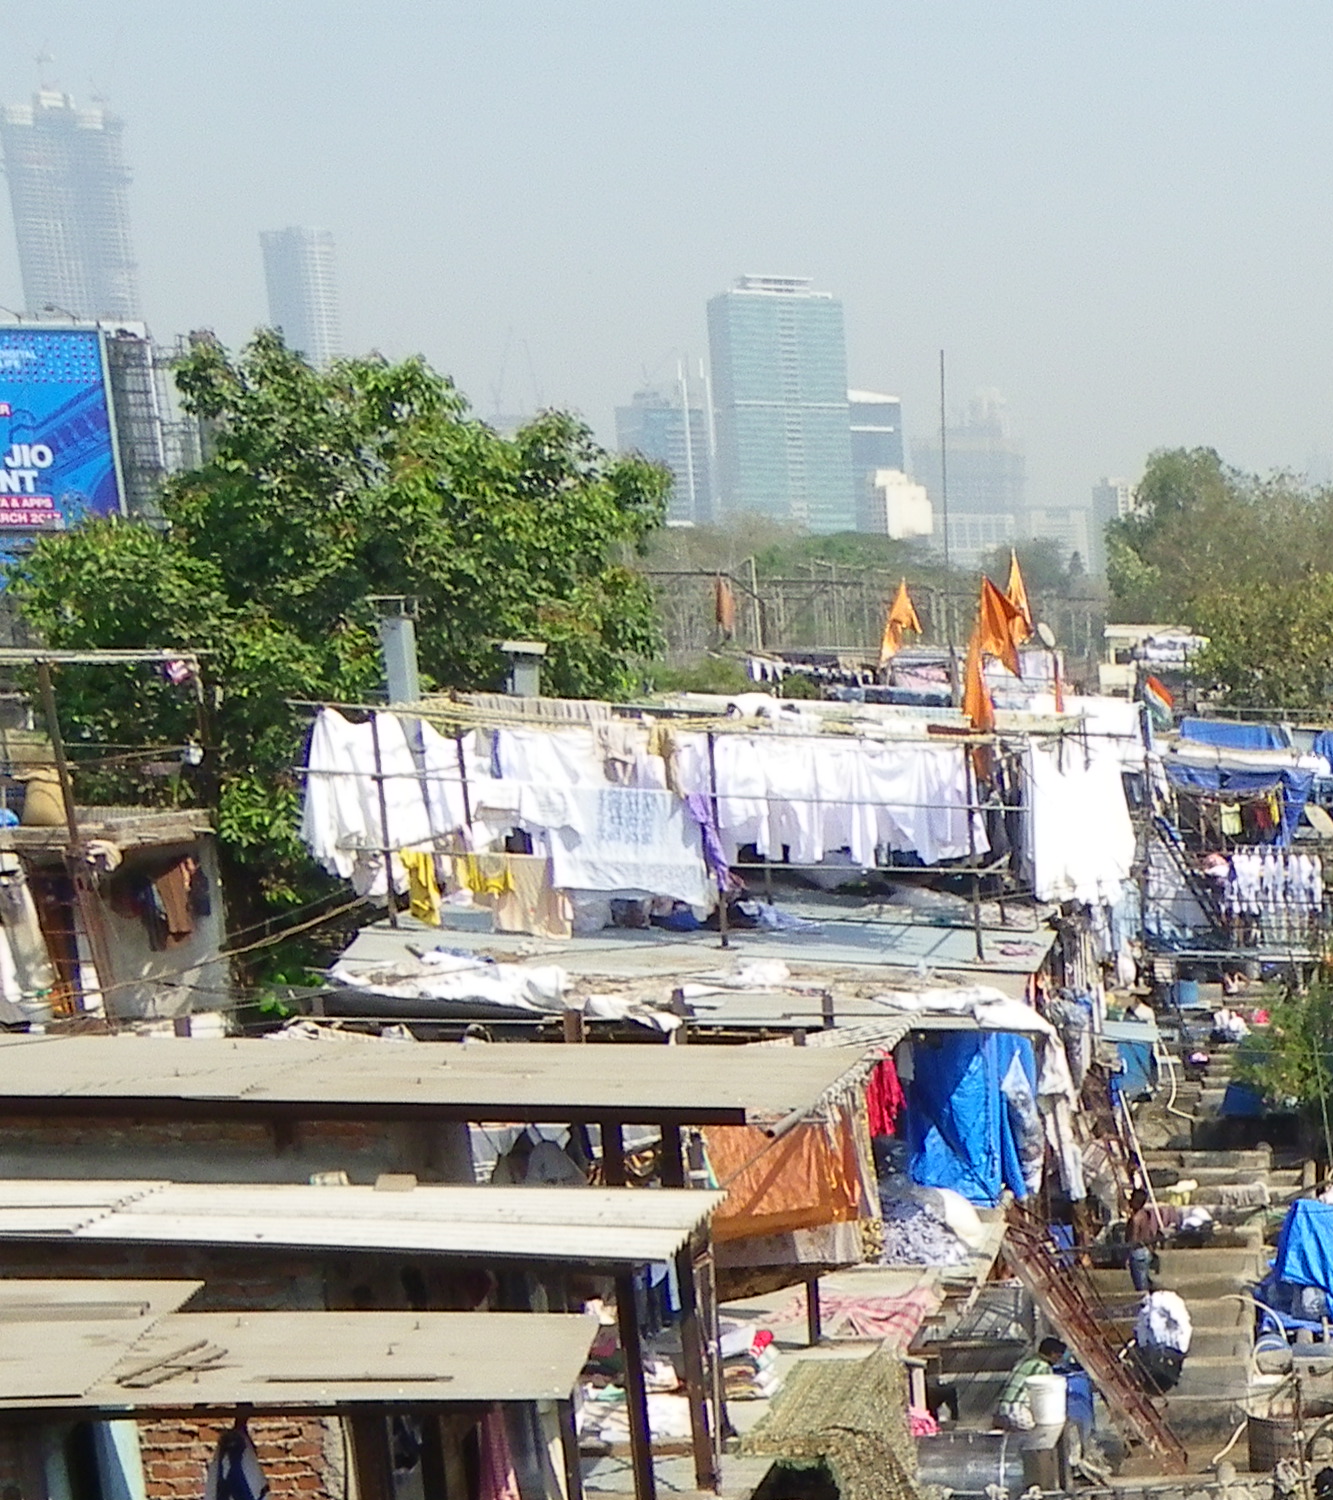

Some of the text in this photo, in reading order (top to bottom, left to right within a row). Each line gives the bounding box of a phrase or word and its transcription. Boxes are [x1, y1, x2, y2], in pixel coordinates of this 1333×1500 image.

[5, 444, 53, 469] JIO
[0, 469, 39, 493] NT
[21, 497, 53, 508] APPS
